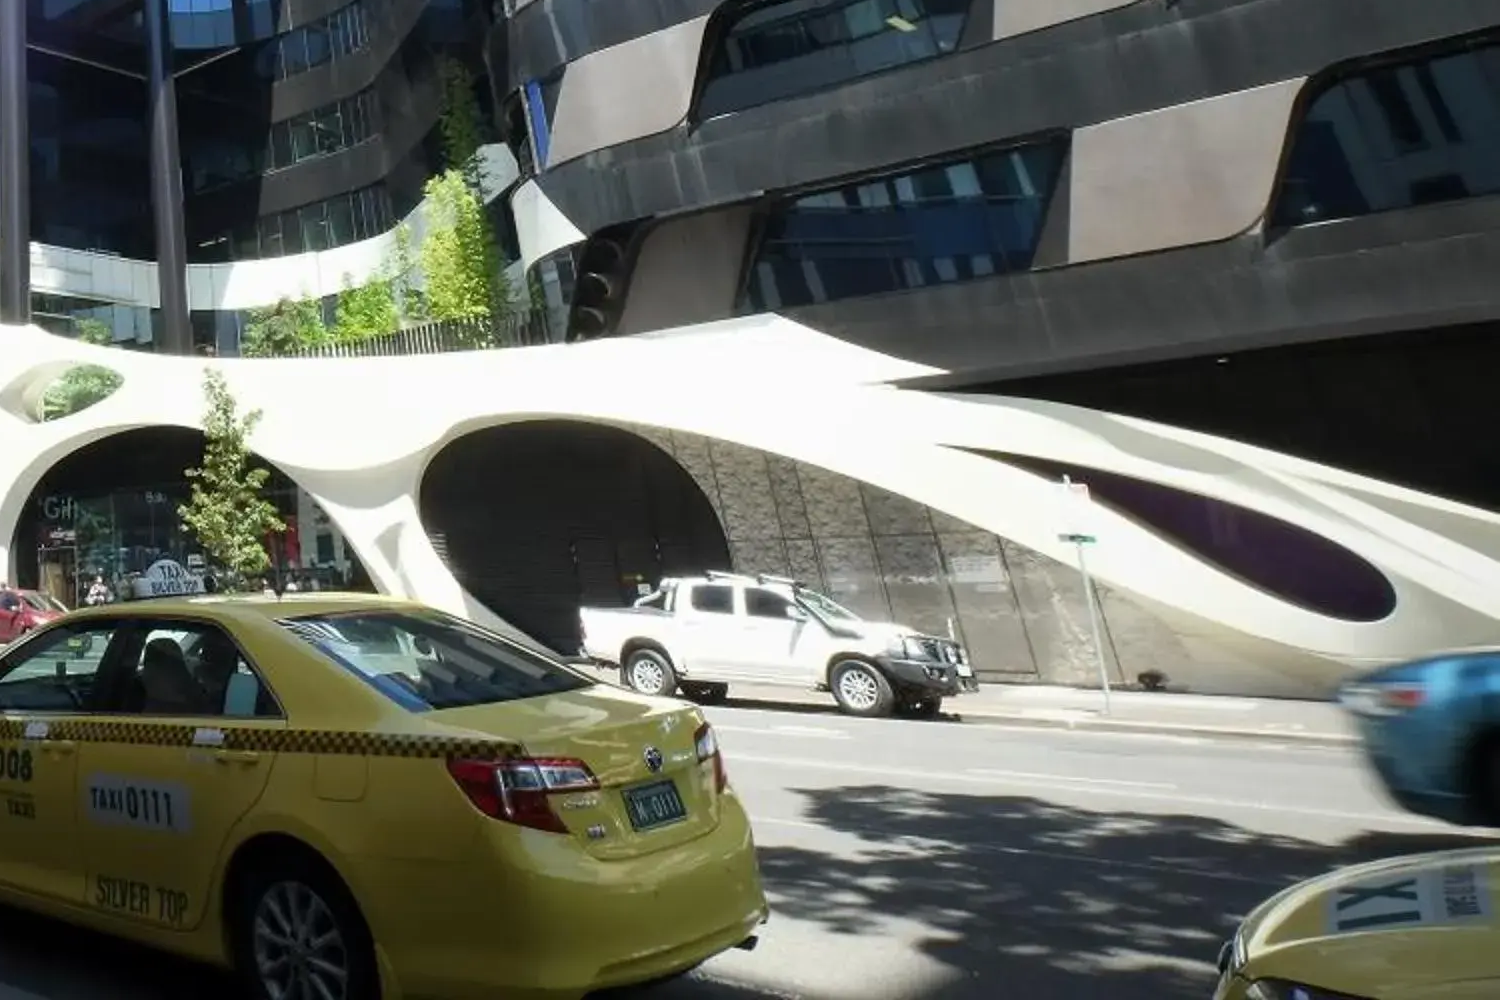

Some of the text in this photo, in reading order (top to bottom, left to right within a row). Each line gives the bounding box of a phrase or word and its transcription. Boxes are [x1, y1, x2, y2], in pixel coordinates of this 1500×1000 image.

[6, 798, 36, 819] TAXI
[90, 785, 174, 828] TAXI 0111
[95, 875, 190, 925] SILVER TOP
